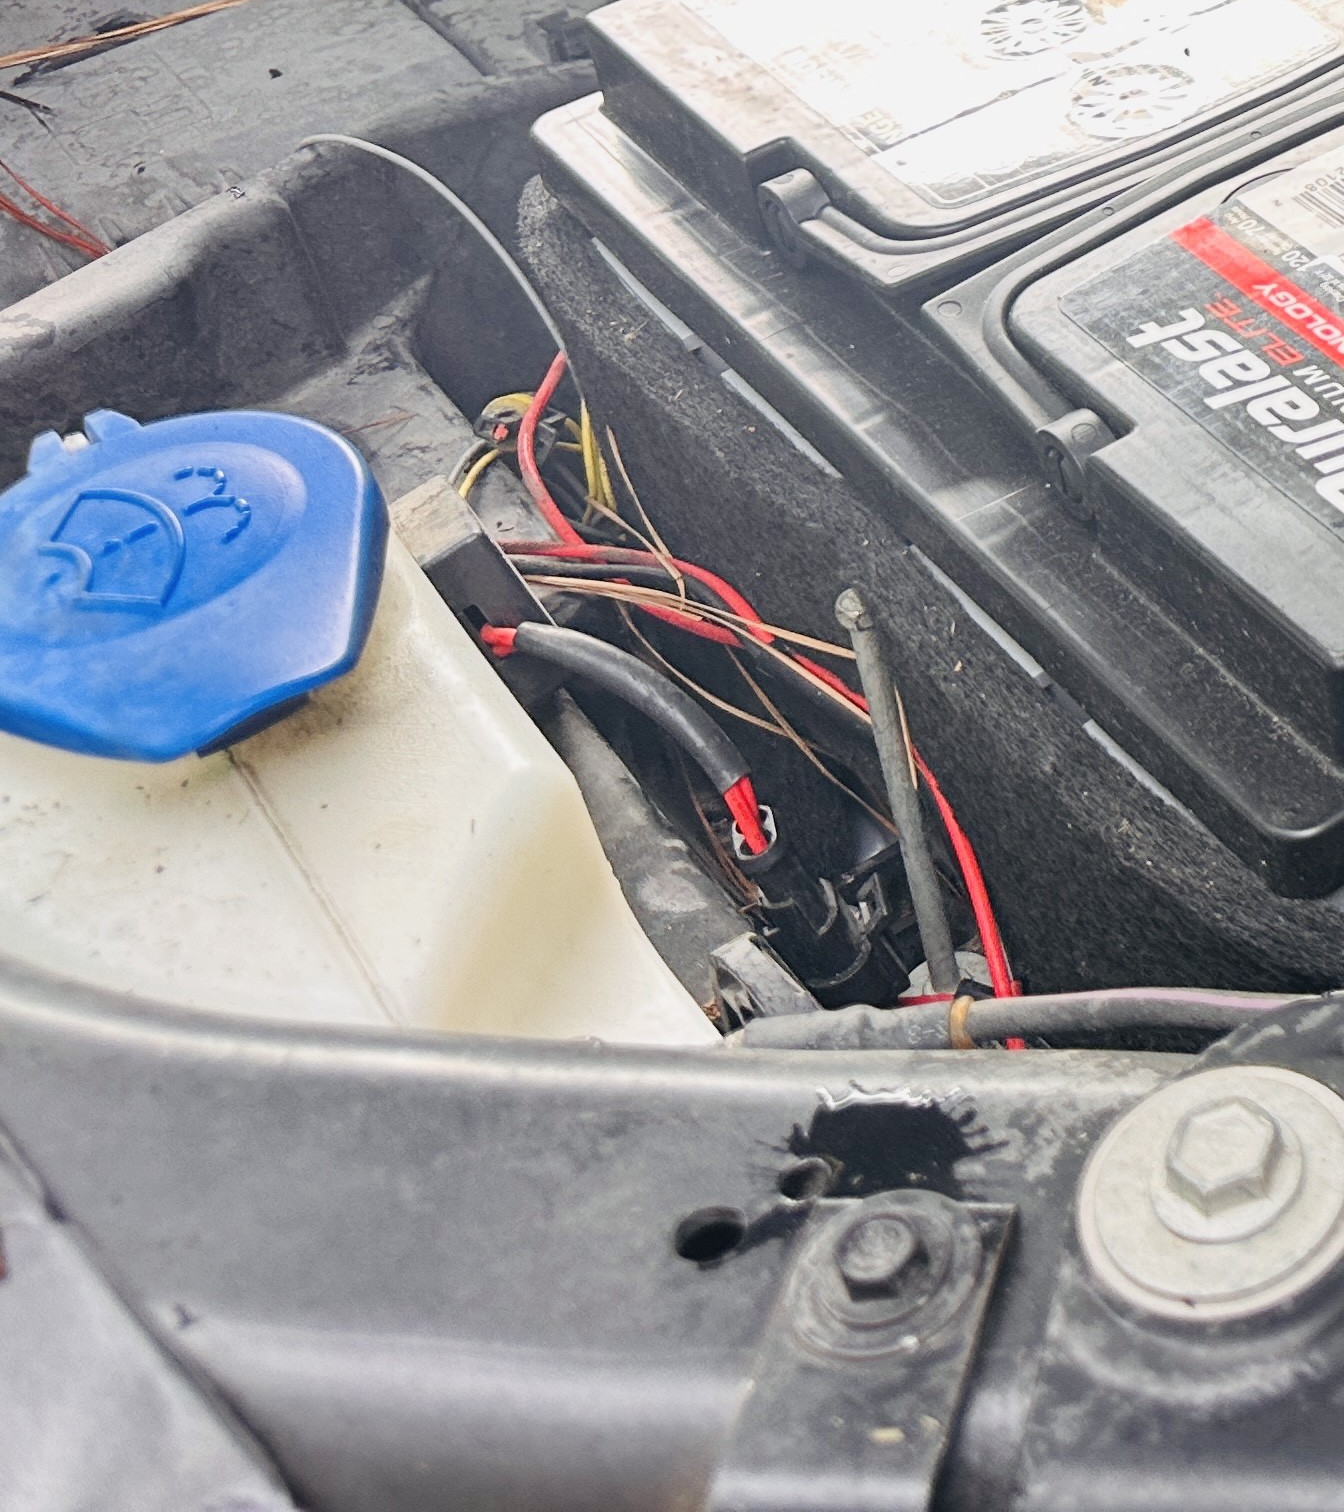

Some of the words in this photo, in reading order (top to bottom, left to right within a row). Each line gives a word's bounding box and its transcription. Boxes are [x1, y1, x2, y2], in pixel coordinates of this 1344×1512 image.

[1234, 216, 1268, 237] 70
[1278, 247, 1319, 274] 120
[1201, 296, 1307, 366] ELITE
